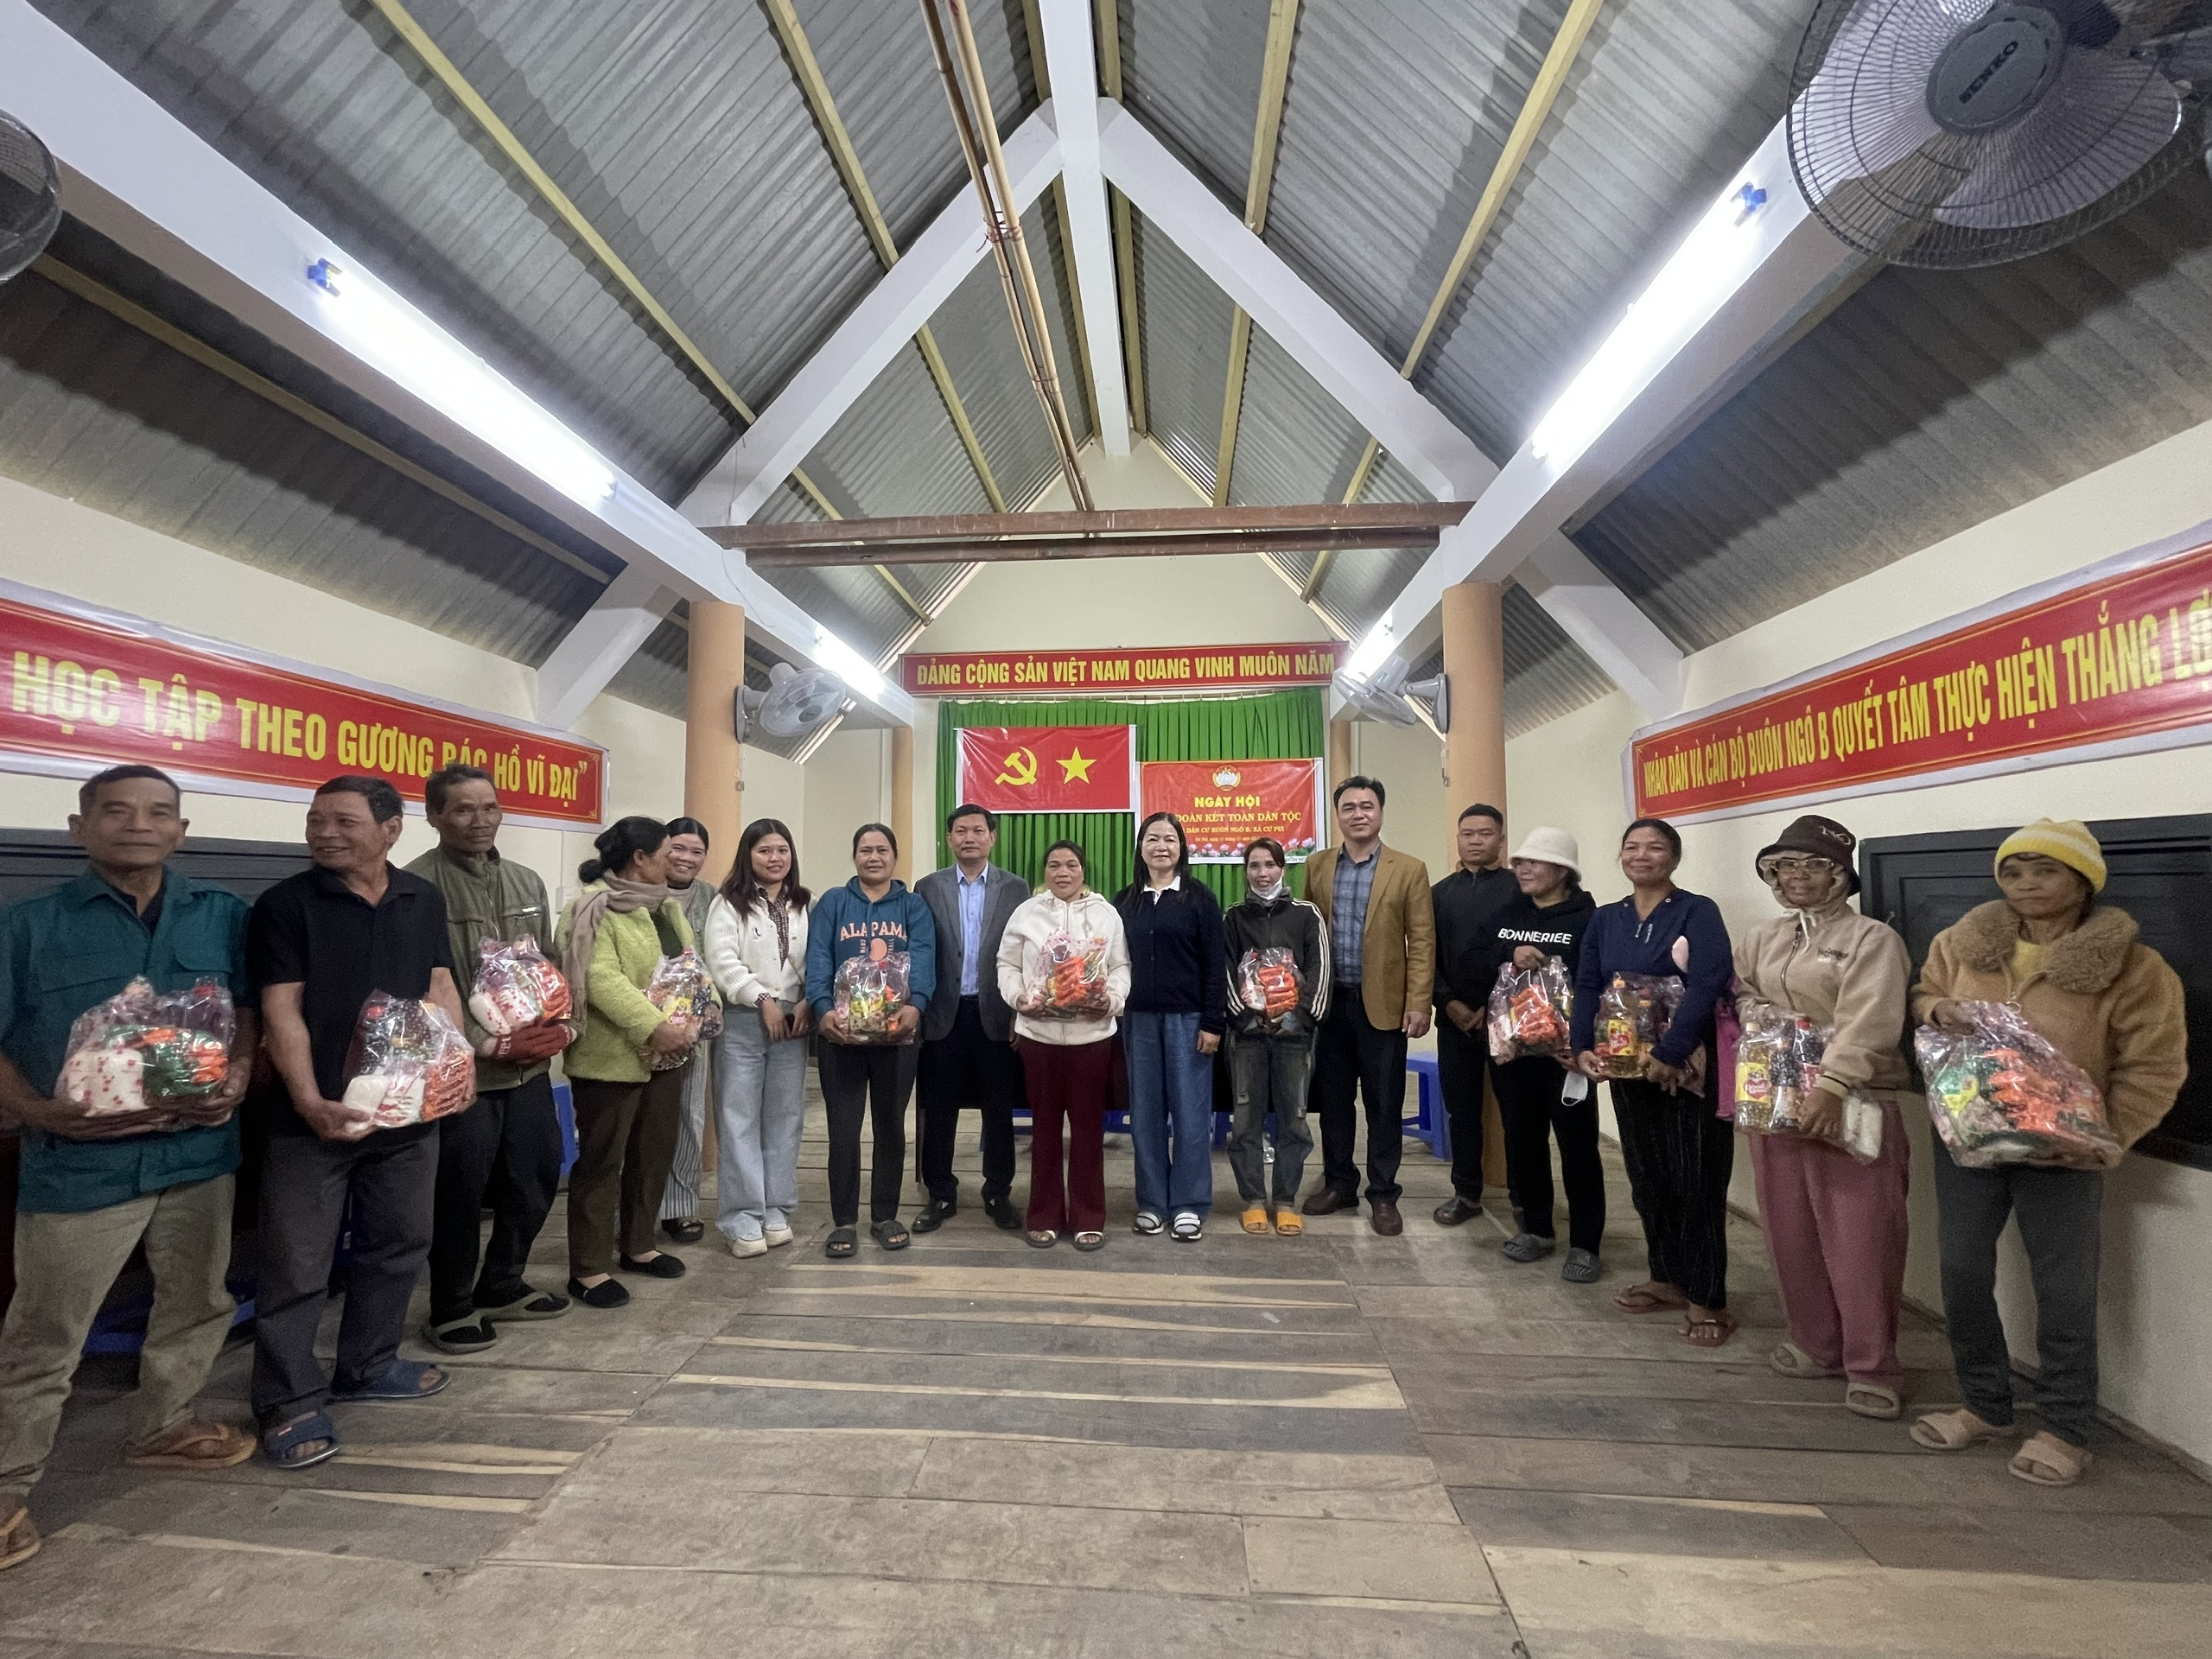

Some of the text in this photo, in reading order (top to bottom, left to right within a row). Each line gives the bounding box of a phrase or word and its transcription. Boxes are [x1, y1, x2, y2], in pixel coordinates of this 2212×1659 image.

[1959, 41, 2019, 104] SENKO
[917, 649, 1335, 689] ĐẢNG CỘNG SẢN VIỆT NAM QUANG VINH MUÔN NĂM
[1643, 751, 1669, 798] NHÂN
[1668, 745, 1689, 793] DÂN
[1689, 739, 1705, 788] VÀ
[1705, 734, 1728, 785] CÁN
[1728, 726, 1746, 788] BỘ
[1747, 716, 1783, 776] BUÔN
[1785, 704, 1815, 767] NGÔ
[1817, 711, 1830, 760] B
[1832, 678, 1884, 762] QUYẾT
[1887, 675, 1930, 745] TÂM
[1933, 660, 1991, 742] THỰC
[1995, 636, 2057, 728] HIỆN
[2061, 599, 2163, 704] THẮNG
[12, 650, 123, 735] HỌC
[138, 672, 222, 751] TẬP
[236, 697, 327, 761] THEO
[338, 720, 434, 778] GƯƠNG
[494, 744, 521, 792] HỒ
[526, 754, 545, 796] VĨ
[1194, 794, 1261, 810] NGÀY HỘI
[1205, 810, 1225, 822] KẾT
[1227, 810, 1255, 822] TOÀN
[1257, 810, 1278, 822] DÂN
[1281, 810, 1301, 823] TỘC
[1497, 927, 1573, 944] BONNERIEE
